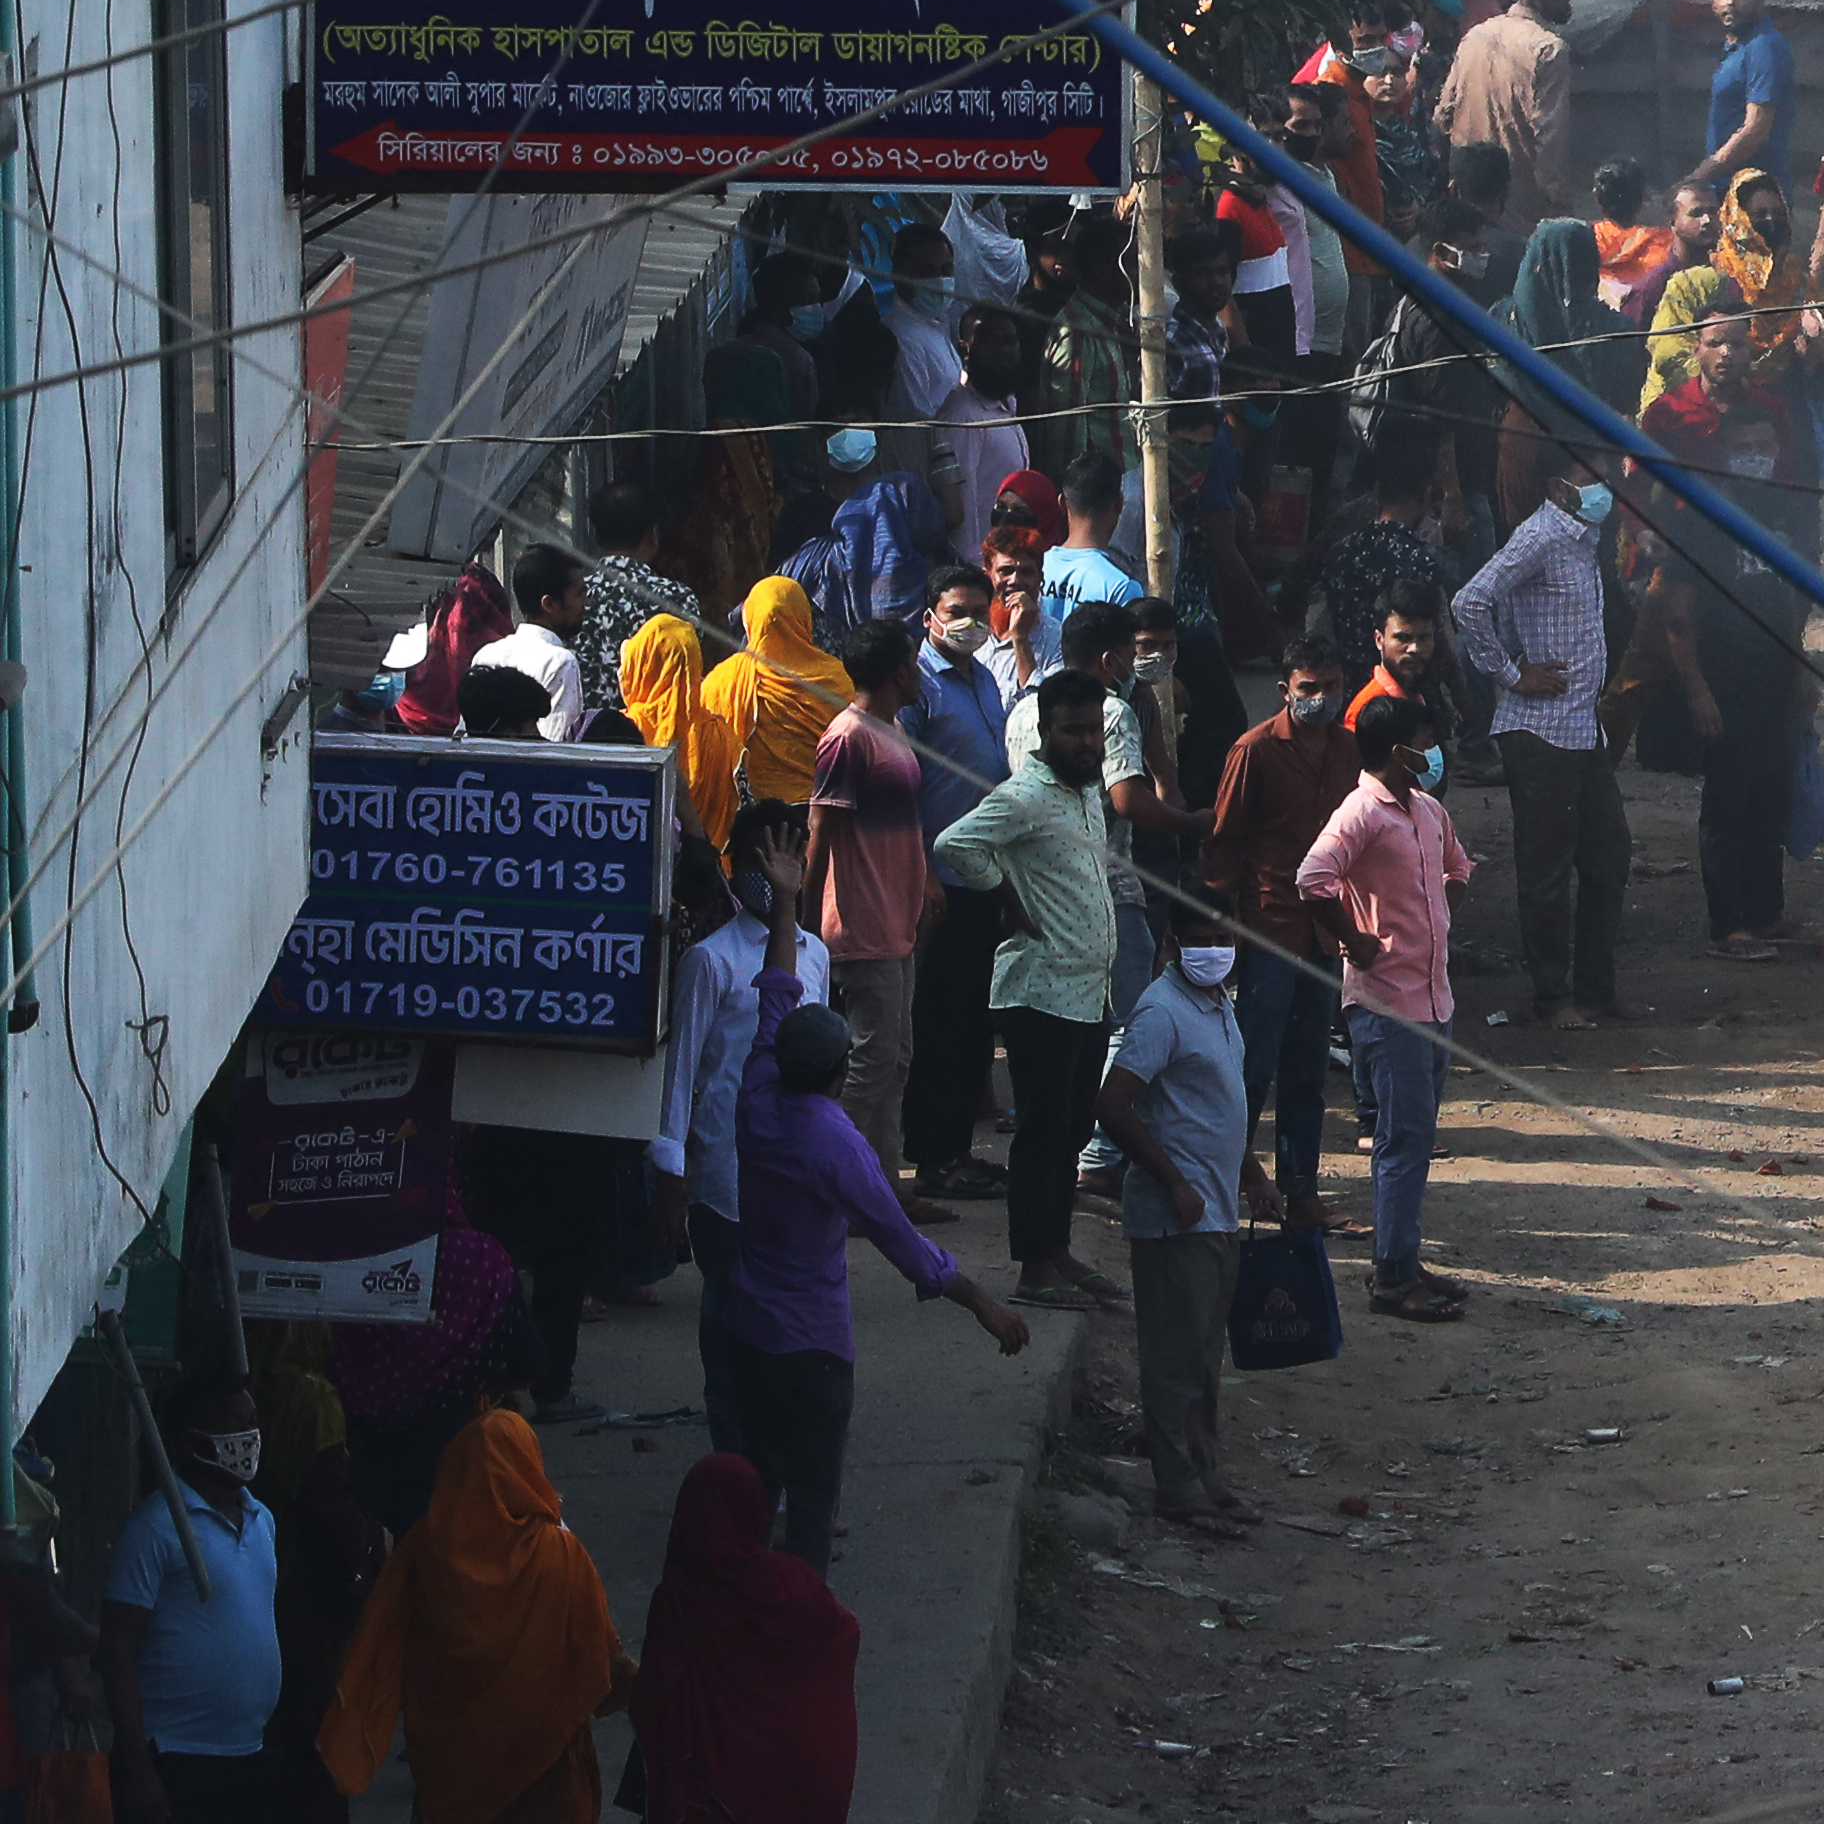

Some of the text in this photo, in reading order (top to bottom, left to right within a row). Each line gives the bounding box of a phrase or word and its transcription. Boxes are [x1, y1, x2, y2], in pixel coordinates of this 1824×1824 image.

[322, 15, 483, 63] (অত্যাধুনিক
[491, 23, 635, 62] হাসপাতাল
[645, 28, 696, 60] এন্ড
[703, 19, 824, 64] ডিজিটাল
[322, 80, 367, 113] মরহুম
[371, 80, 420, 109] সাদেক
[424, 71, 462, 110] আলী
[466, 81, 507, 116] সুপার
[512, 73, 563, 116] মার্কেট,
[569, 79, 632, 113] নাওজোর
[637, 76, 723, 114] ফ্লাইওভারের
[729, 79, 771, 114] পশ্চিম
[824, 80, 898, 123] ইসলামপুর
[958, 88, 996, 123] মাথা,
[1001, 80, 1059, 125] গাজীপুর
[375, 131, 502, 166] সিরিয়ালের
[511, 140, 562, 166] জন্য
[831, 147, 1049, 173] ০১৯৭২-০৮৫০৮৬
[313, 770, 651, 843] সেবা হোমিও কটেজ
[312, 848, 627, 894] 01760-761135
[365, 906, 645, 980] মেডিসিন কর্ণার
[306, 979, 616, 1026] 01719-037532
[277, 1170, 395, 1194] সহজে ও নিরাপদে
[292, 1147, 385, 1173] টাকা পাঠান
